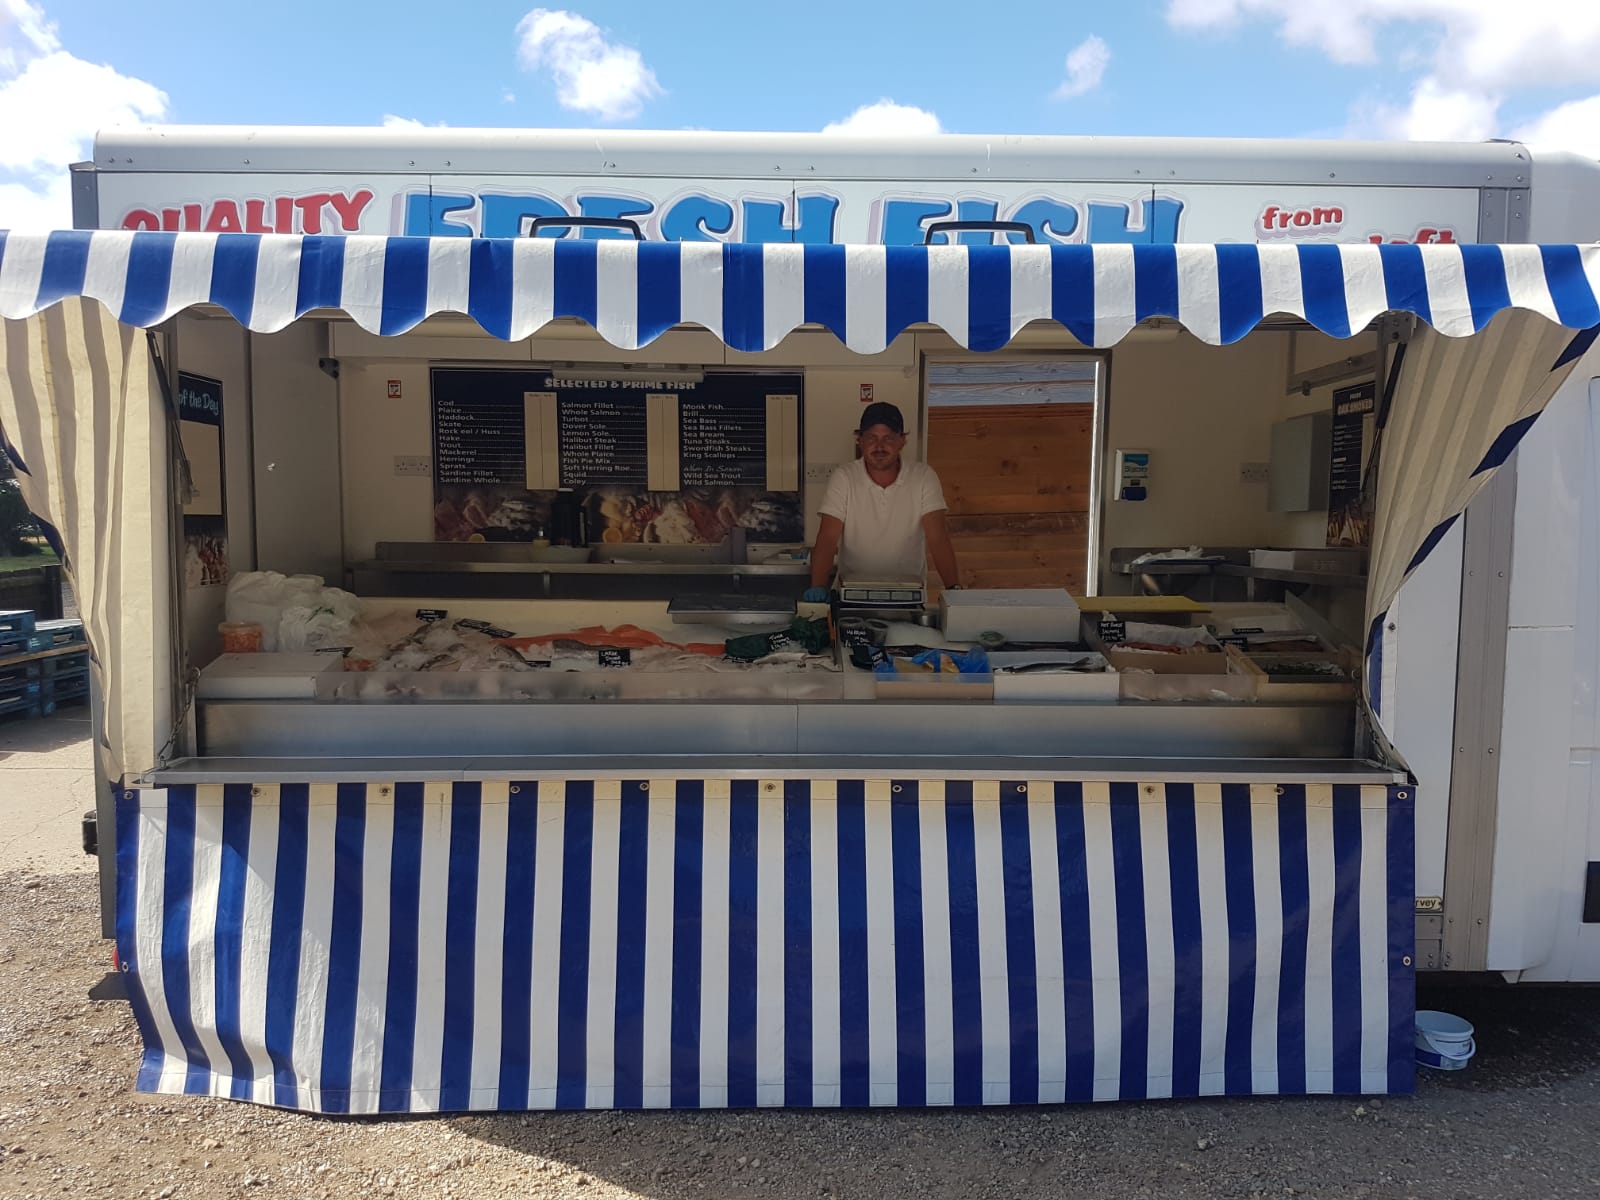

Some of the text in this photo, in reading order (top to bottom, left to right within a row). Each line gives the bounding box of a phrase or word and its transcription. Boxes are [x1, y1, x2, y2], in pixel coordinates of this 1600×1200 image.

[1260, 207, 1343, 229] from
[544, 378, 696, 390] SELECTED & PRIME FISH
[189, 391, 202, 408] the
[202, 393, 219, 416] Day
[683, 452, 736, 460] King Scallops
[563, 464, 630, 472] Soft Herring Roe
[563, 471, 587, 479] Squid
